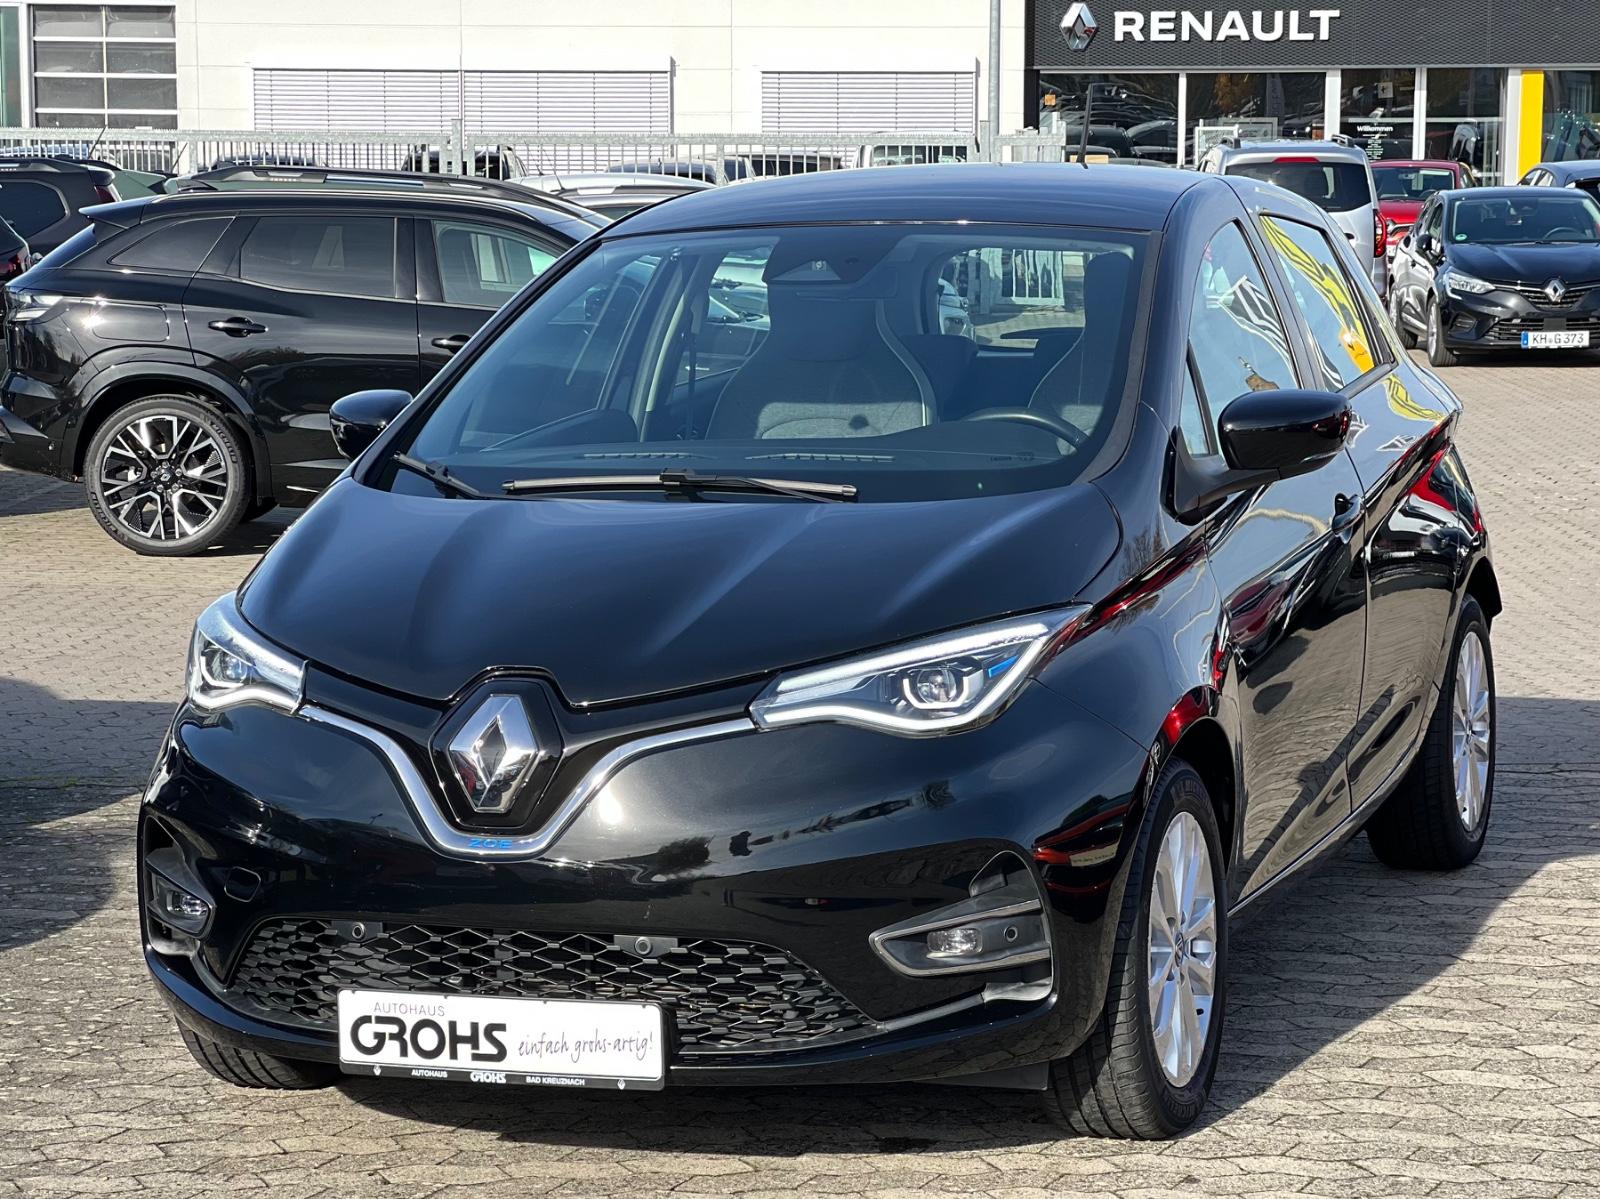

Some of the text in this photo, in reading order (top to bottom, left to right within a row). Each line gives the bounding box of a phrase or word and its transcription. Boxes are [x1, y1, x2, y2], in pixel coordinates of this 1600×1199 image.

[1114, 10, 1340, 41] RENAULT
[1532, 333, 1547, 344] KH
[468, 838, 513, 848] ZOE
[374, 1001, 445, 1017] AUTOHAUS
[350, 1014, 508, 1063] GROHS
[518, 1027, 653, 1063] einfach grohs-artig!
[411, 1068, 586, 1086] AUTOHAUS GROHS BAD KREUZNACH
